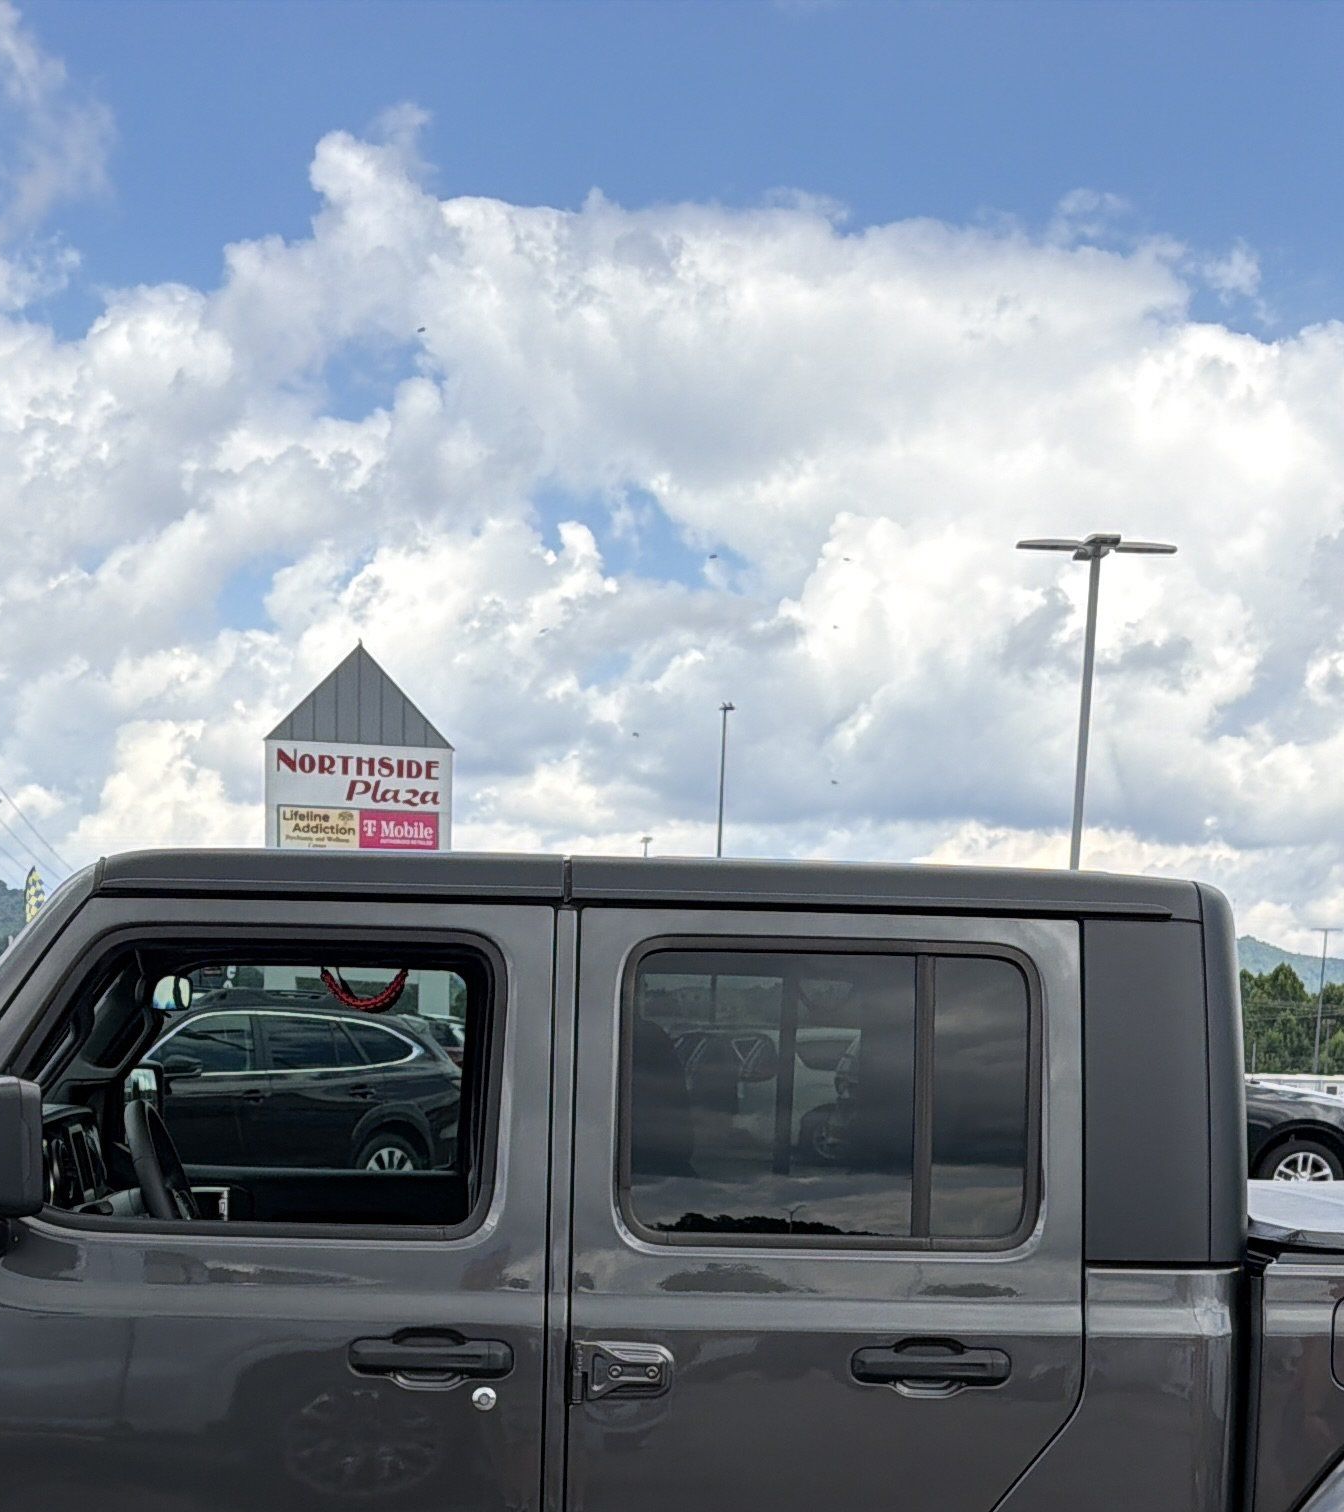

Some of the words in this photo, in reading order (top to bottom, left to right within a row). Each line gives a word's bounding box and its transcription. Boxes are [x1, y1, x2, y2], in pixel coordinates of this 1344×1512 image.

[345, 779, 441, 807] Plaza
[282, 810, 331, 823] Lifeline
[291, 822, 356, 837] Addiction
[380, 820, 434, 839] Mobile
